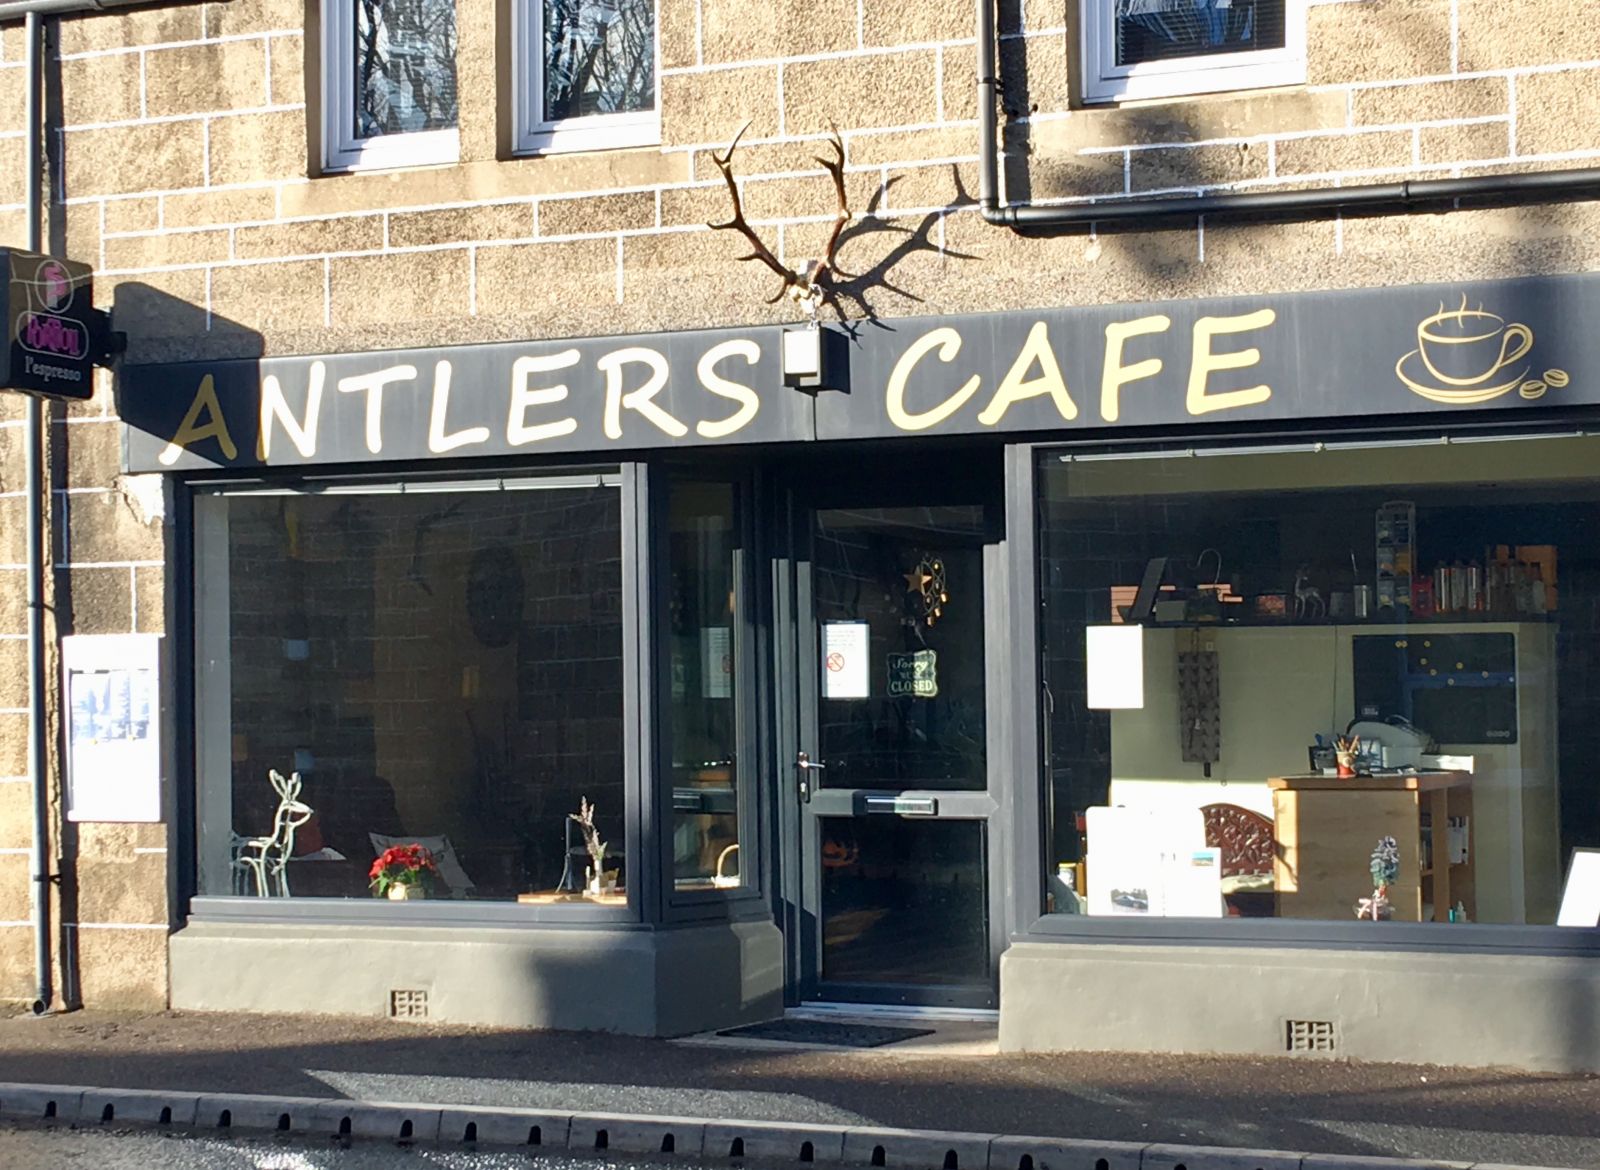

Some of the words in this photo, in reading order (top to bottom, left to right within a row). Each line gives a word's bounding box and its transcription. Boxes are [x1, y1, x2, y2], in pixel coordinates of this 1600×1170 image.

[24, 355, 81, 382] l'espresso
[158, 338, 761, 466] ANTLERS
[885, 308, 1277, 431] CAFE
[891, 680, 933, 692] CLOSED
